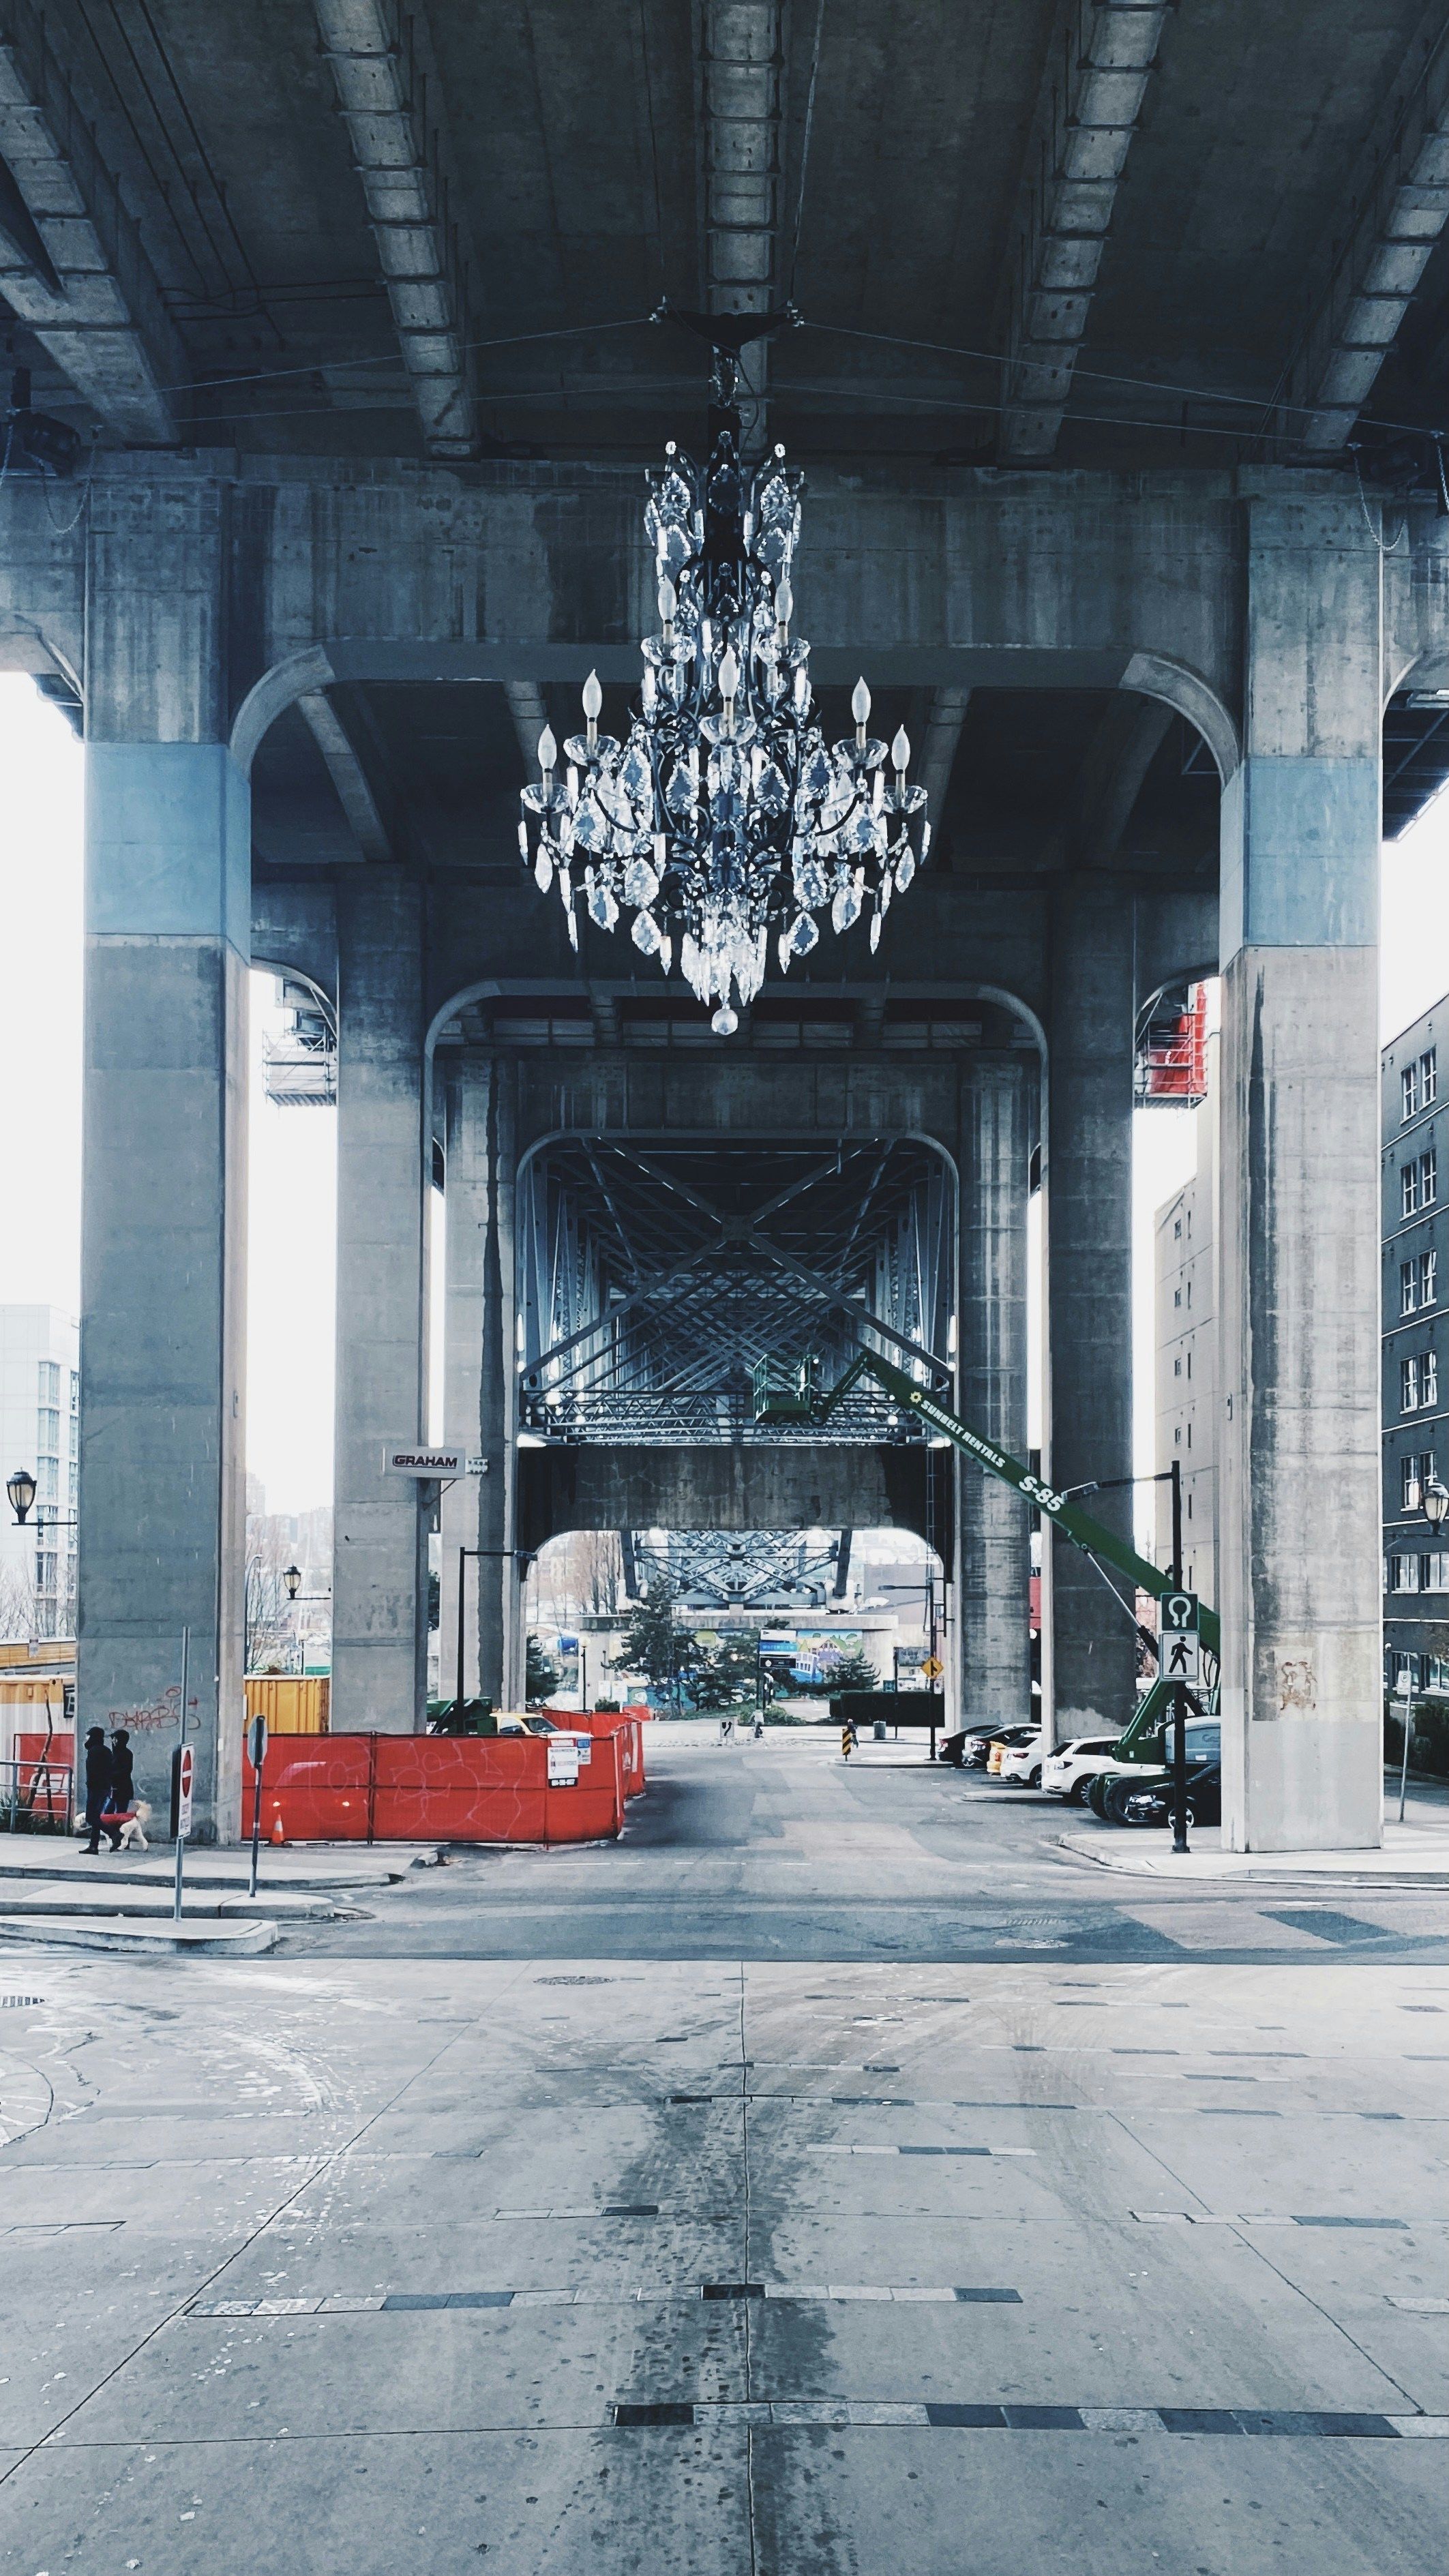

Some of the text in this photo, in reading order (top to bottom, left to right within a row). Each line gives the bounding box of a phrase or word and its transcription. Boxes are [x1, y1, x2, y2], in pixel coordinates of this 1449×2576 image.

[921, 1400, 1006, 1468] SUNBELT RENTALS
[393, 1455, 458, 1467] GRAHAM
[1019, 1476, 1065, 1512] S-85
